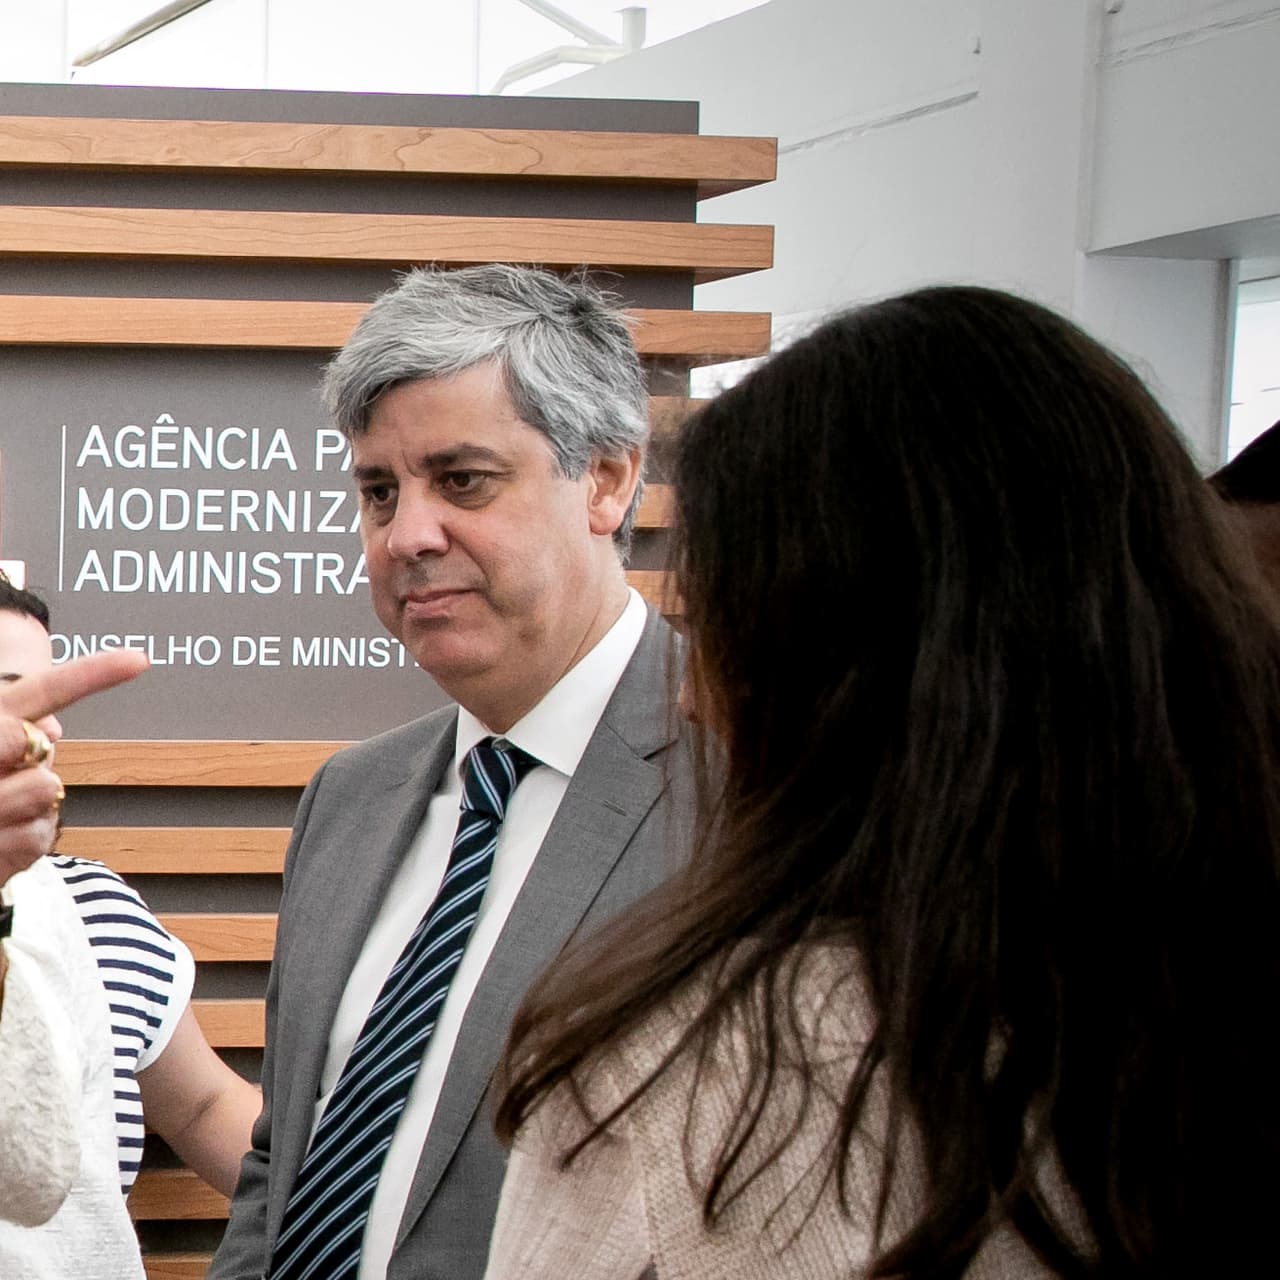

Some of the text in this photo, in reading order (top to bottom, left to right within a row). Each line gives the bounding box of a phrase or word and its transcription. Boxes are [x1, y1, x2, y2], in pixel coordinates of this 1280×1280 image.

[76, 413, 297, 472] AGÊNCIA
[232, 635, 282, 666] DE
[292, 637, 421, 668] MINIST
